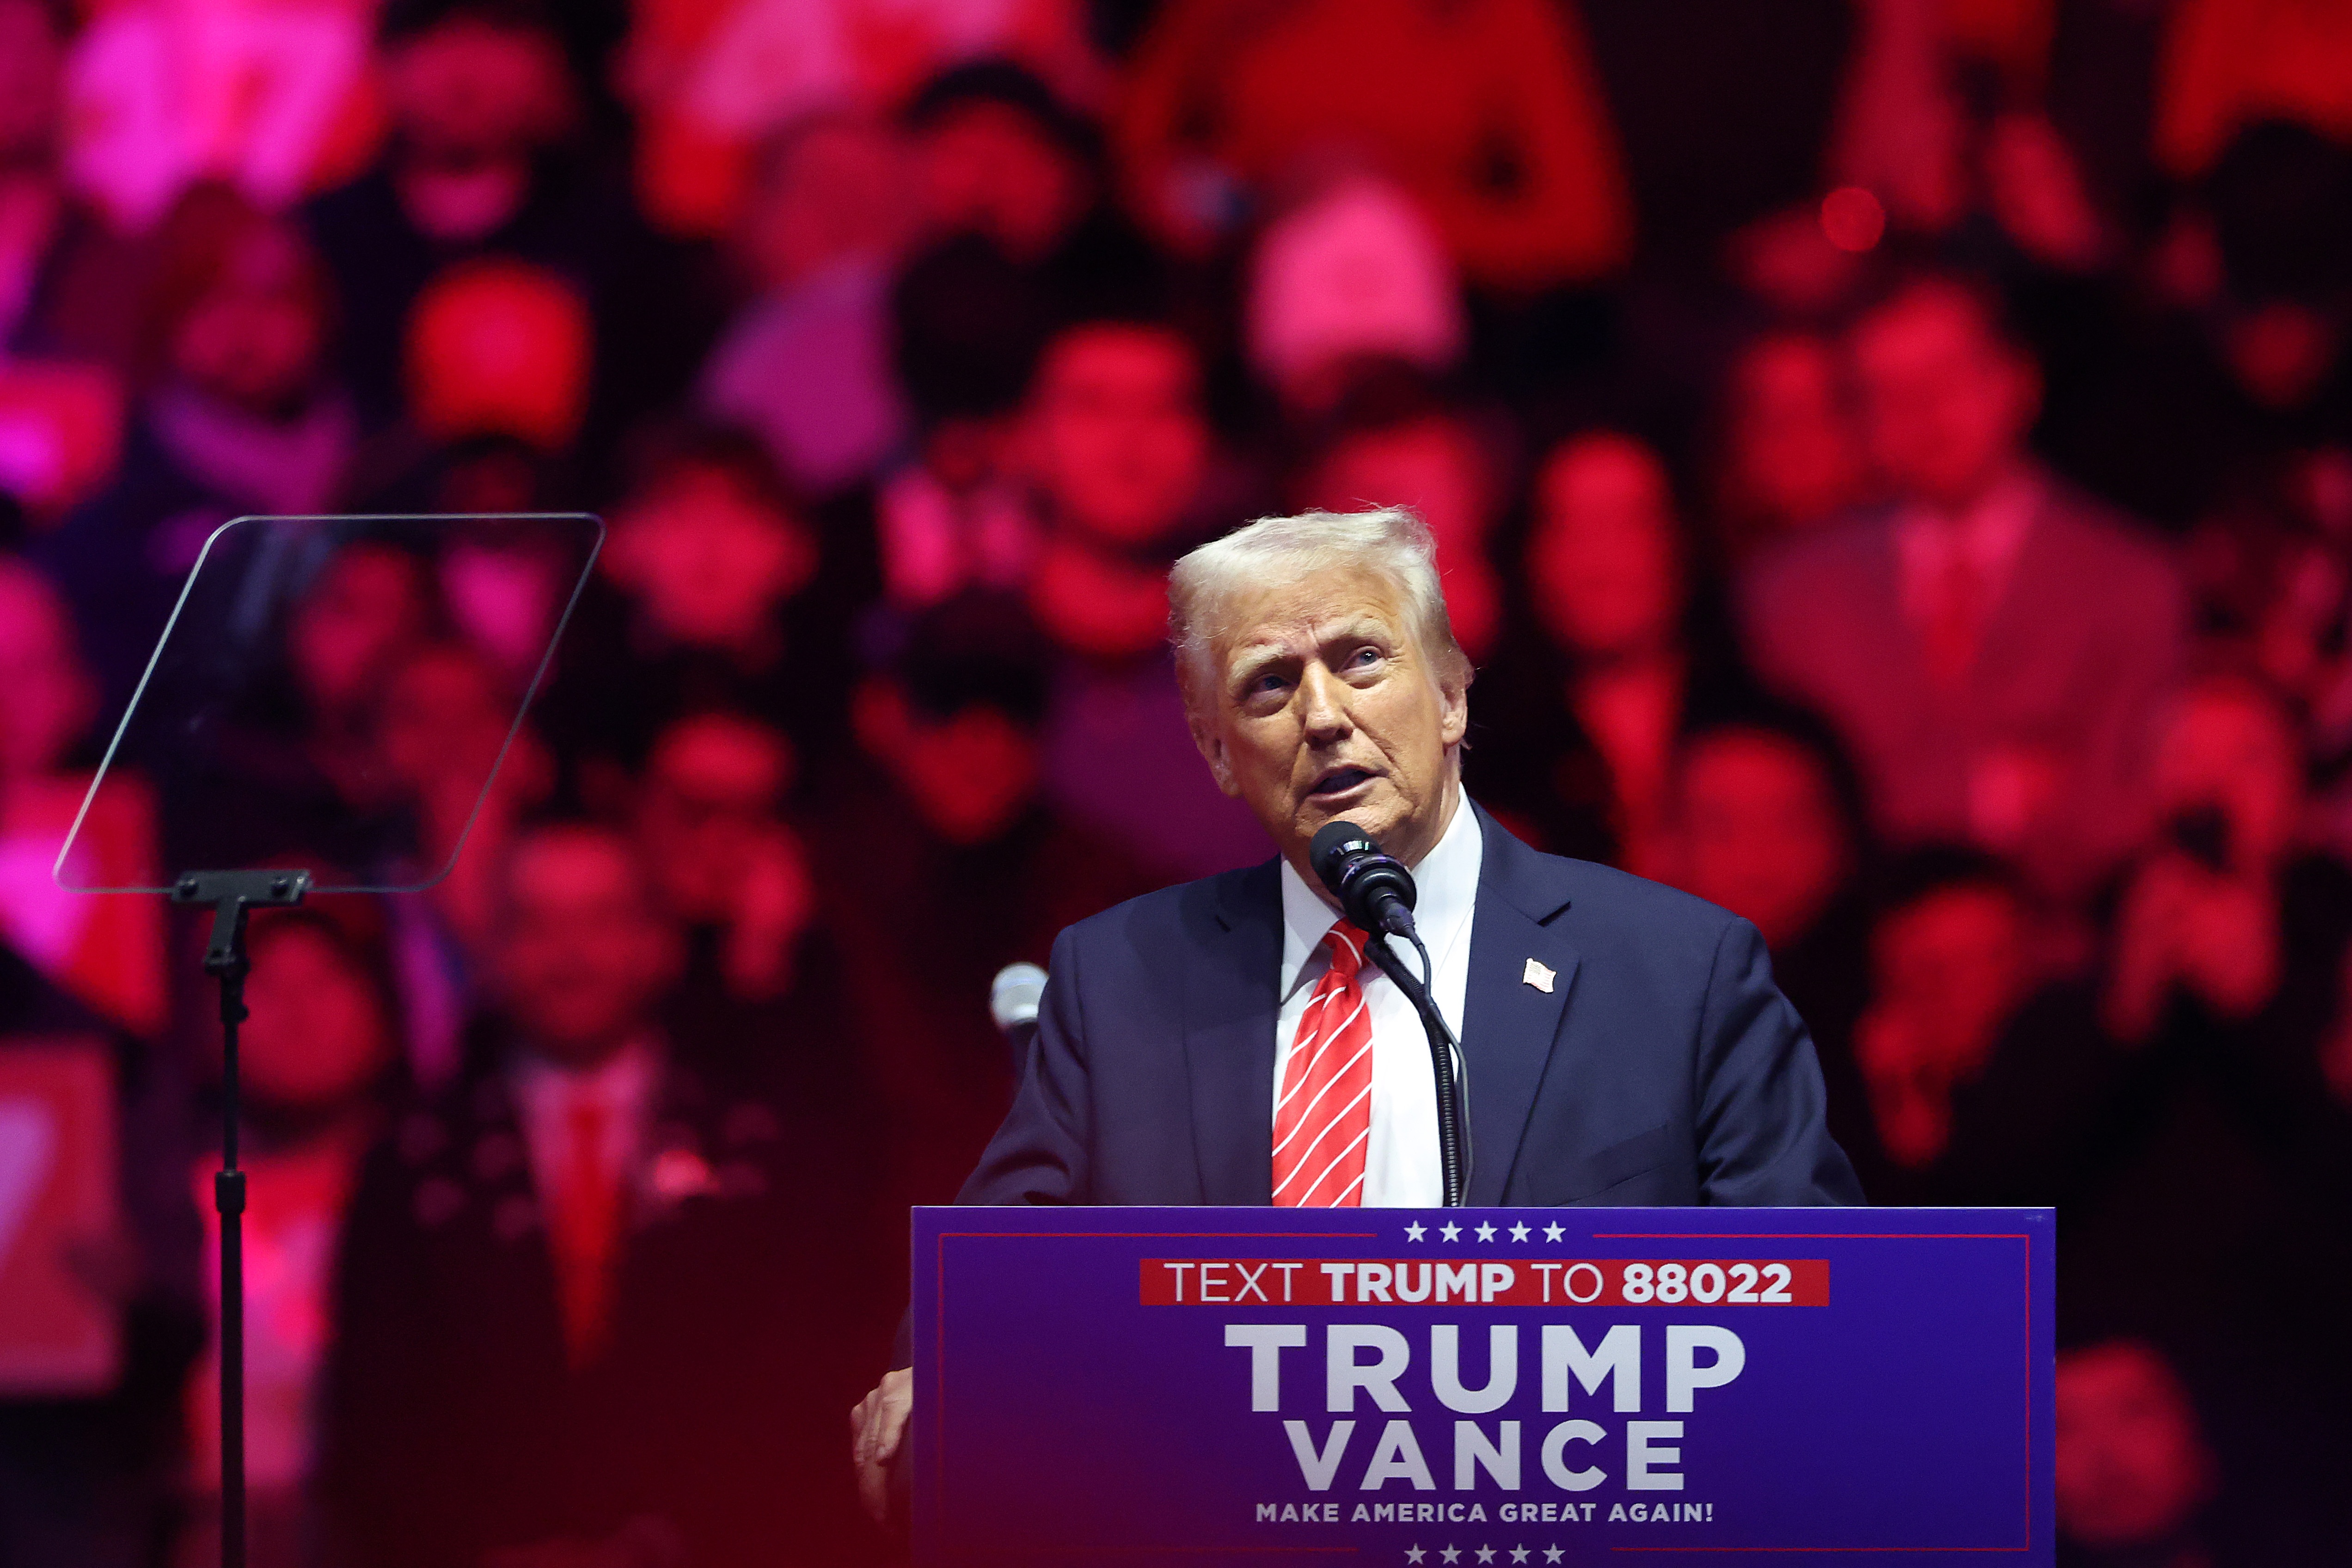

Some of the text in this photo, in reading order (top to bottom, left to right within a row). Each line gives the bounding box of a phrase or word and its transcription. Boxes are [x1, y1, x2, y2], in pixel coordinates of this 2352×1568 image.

[1164, 1263, 1792, 1303] TEXT TRUMP TO 88022
[1225, 1325, 1746, 1414] TRUMP
[1284, 1420, 1684, 1491] VANCE
[1256, 1503, 1713, 1522] MAKE AMERICA GREAT AGAIN!
